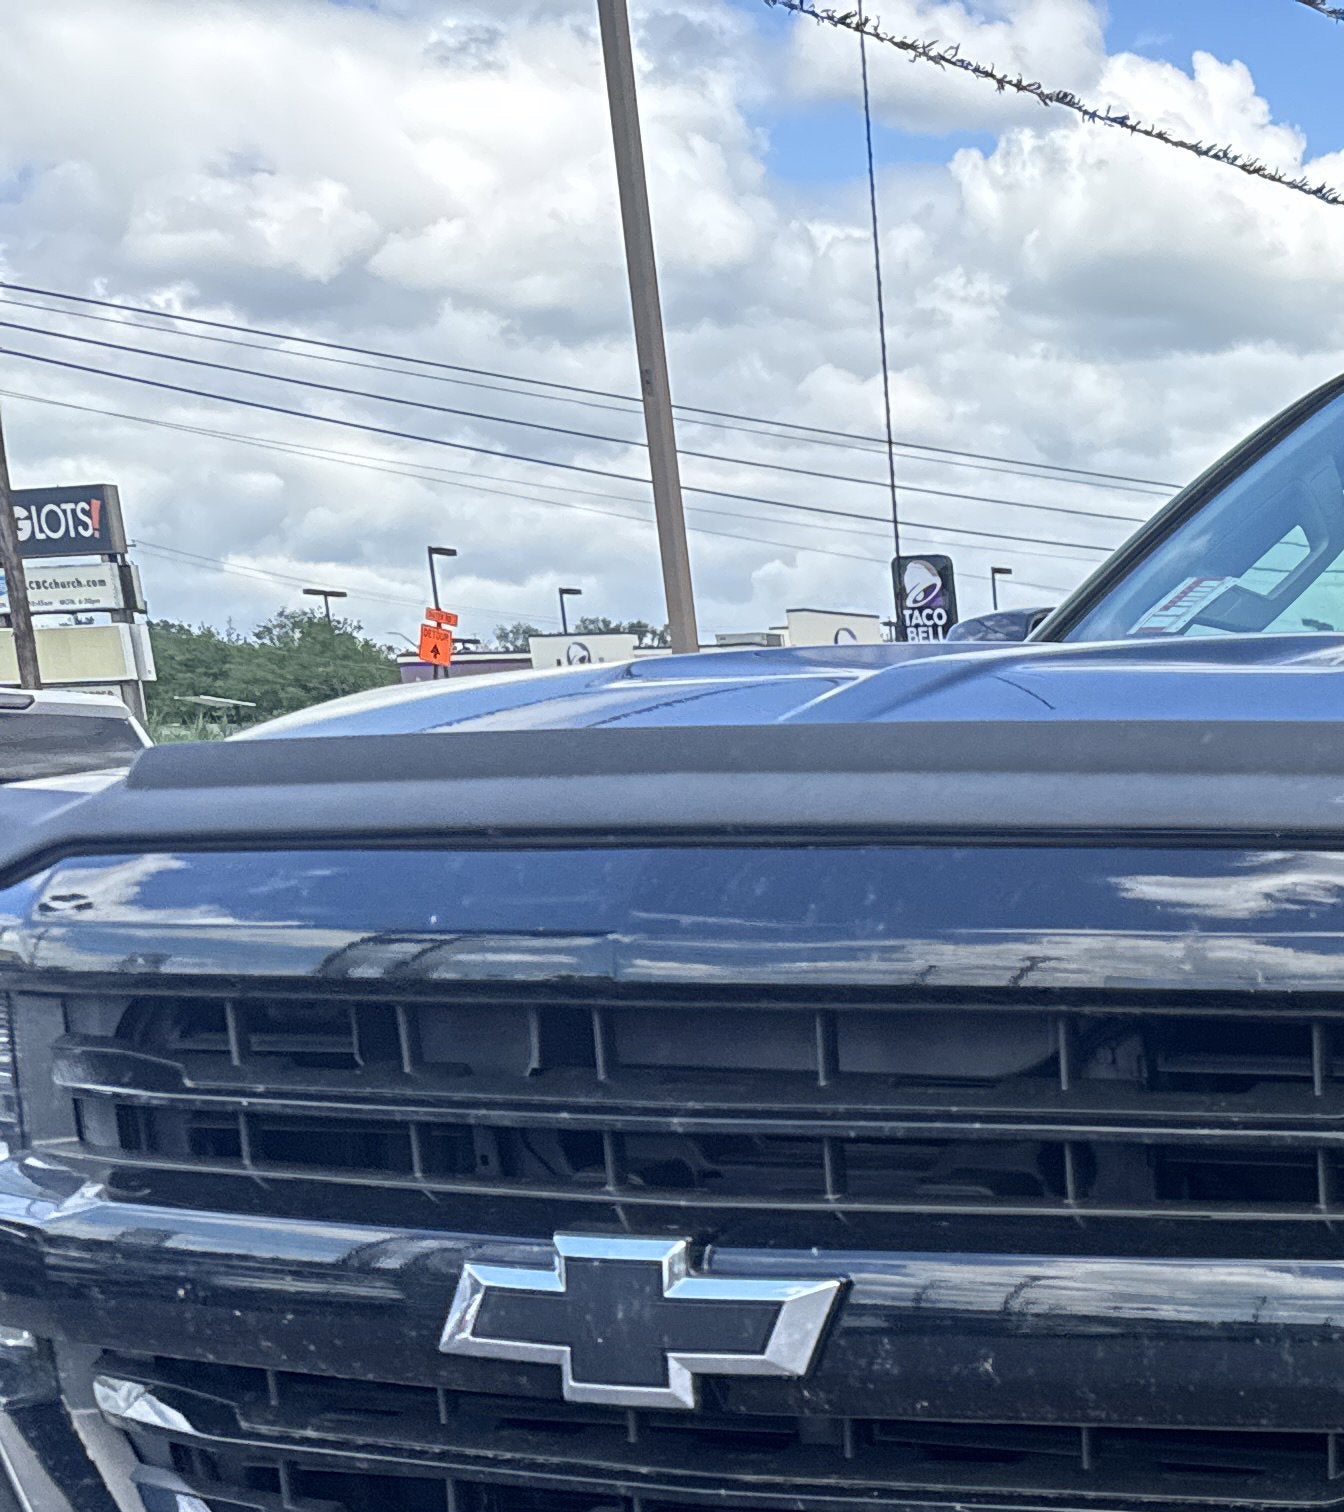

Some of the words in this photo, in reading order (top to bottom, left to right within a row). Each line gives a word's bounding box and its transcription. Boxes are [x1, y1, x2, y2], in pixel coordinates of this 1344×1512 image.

[26, 577, 107, 591] CBCchurch.com
[903, 607, 947, 626] TACO
[906, 625, 944, 642] BELL
